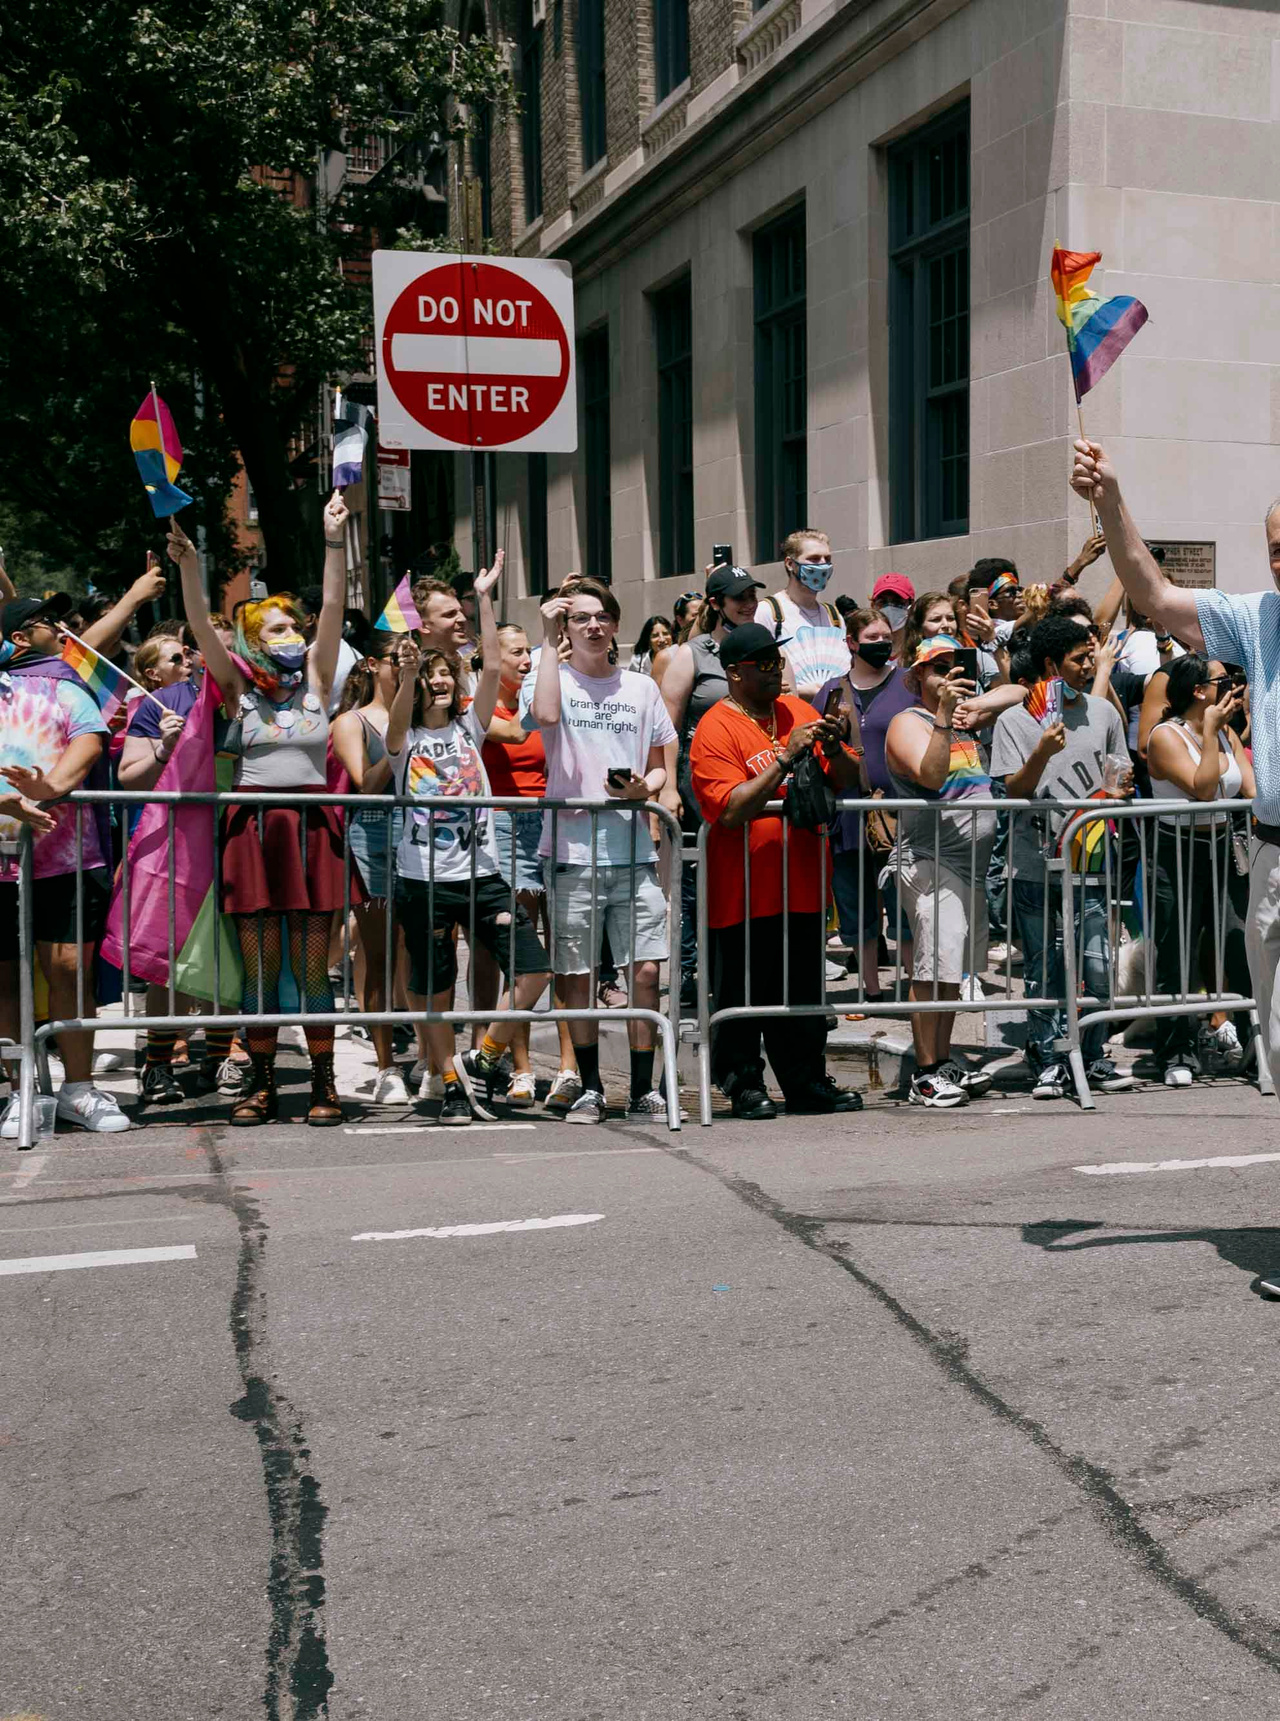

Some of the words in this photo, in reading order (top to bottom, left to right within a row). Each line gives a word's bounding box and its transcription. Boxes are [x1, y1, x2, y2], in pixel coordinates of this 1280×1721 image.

[417, 295, 460, 324] DO
[473, 298, 533, 327] NOT
[427, 383, 530, 413] ENTER
[570, 697, 600, 711] trans
[603, 701, 637, 715] rights
[594, 711, 612, 721] are
[606, 721, 638, 734] rights
